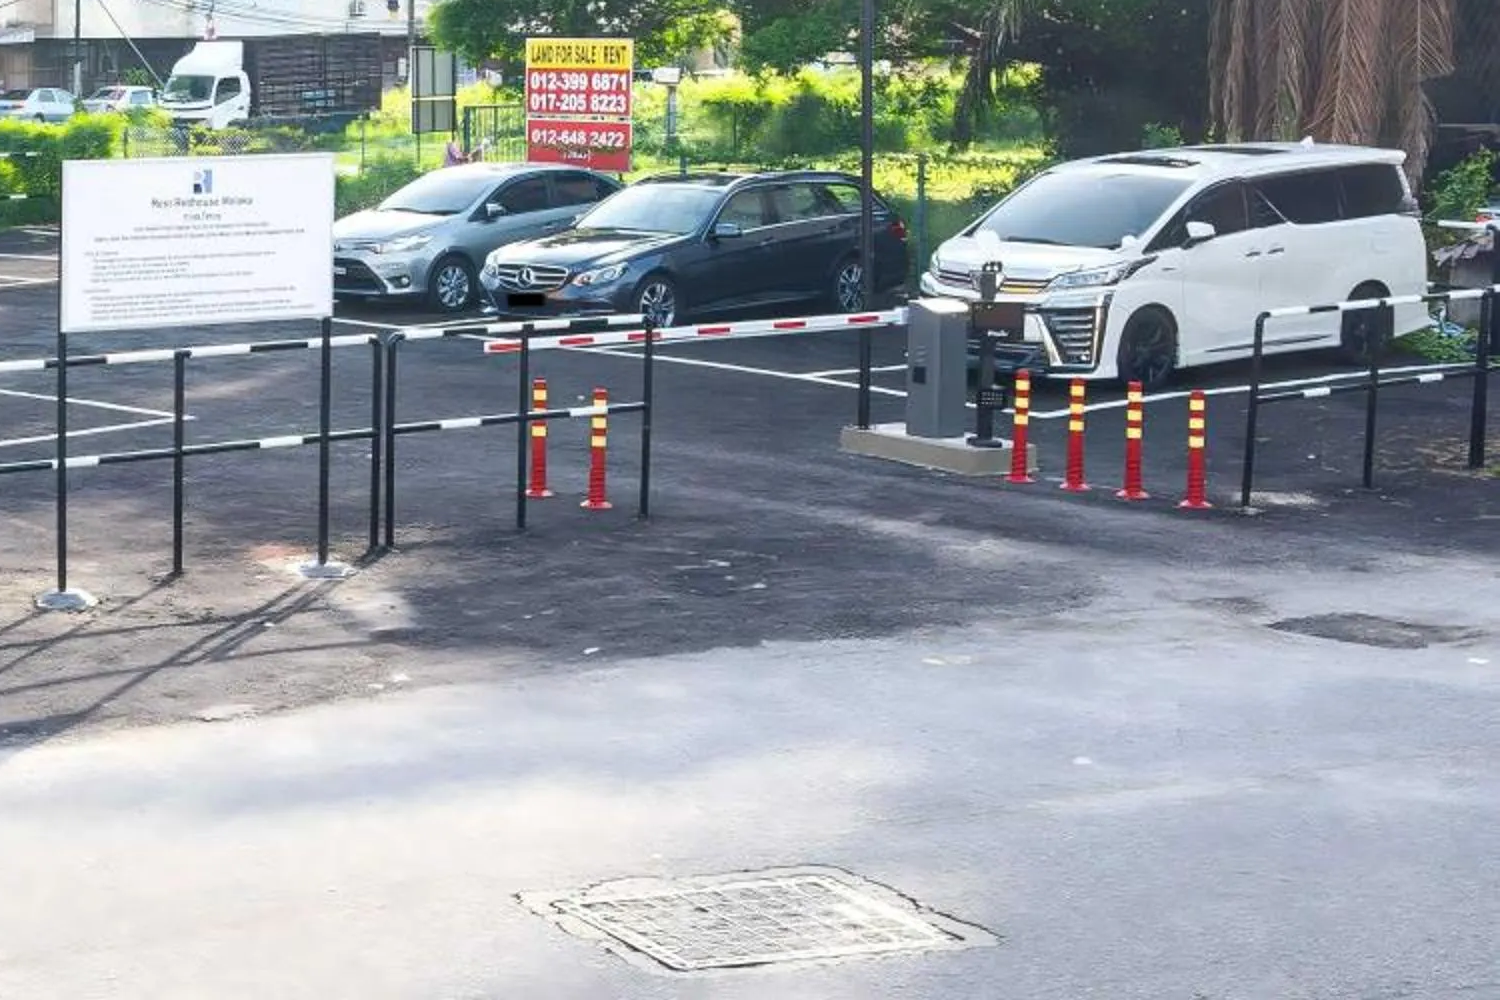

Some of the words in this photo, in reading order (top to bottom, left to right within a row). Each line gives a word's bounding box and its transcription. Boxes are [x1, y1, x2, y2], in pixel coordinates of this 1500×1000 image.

[531, 45, 553, 63] LAND
[555, 45, 572, 63] FOR
[574, 45, 597, 64] SALE
[603, 45, 627, 64] RENT
[530, 72, 588, 91] 012-399
[591, 72, 627, 91] 6871
[530, 93, 587, 112] 017-205
[590, 94, 627, 113] 8223
